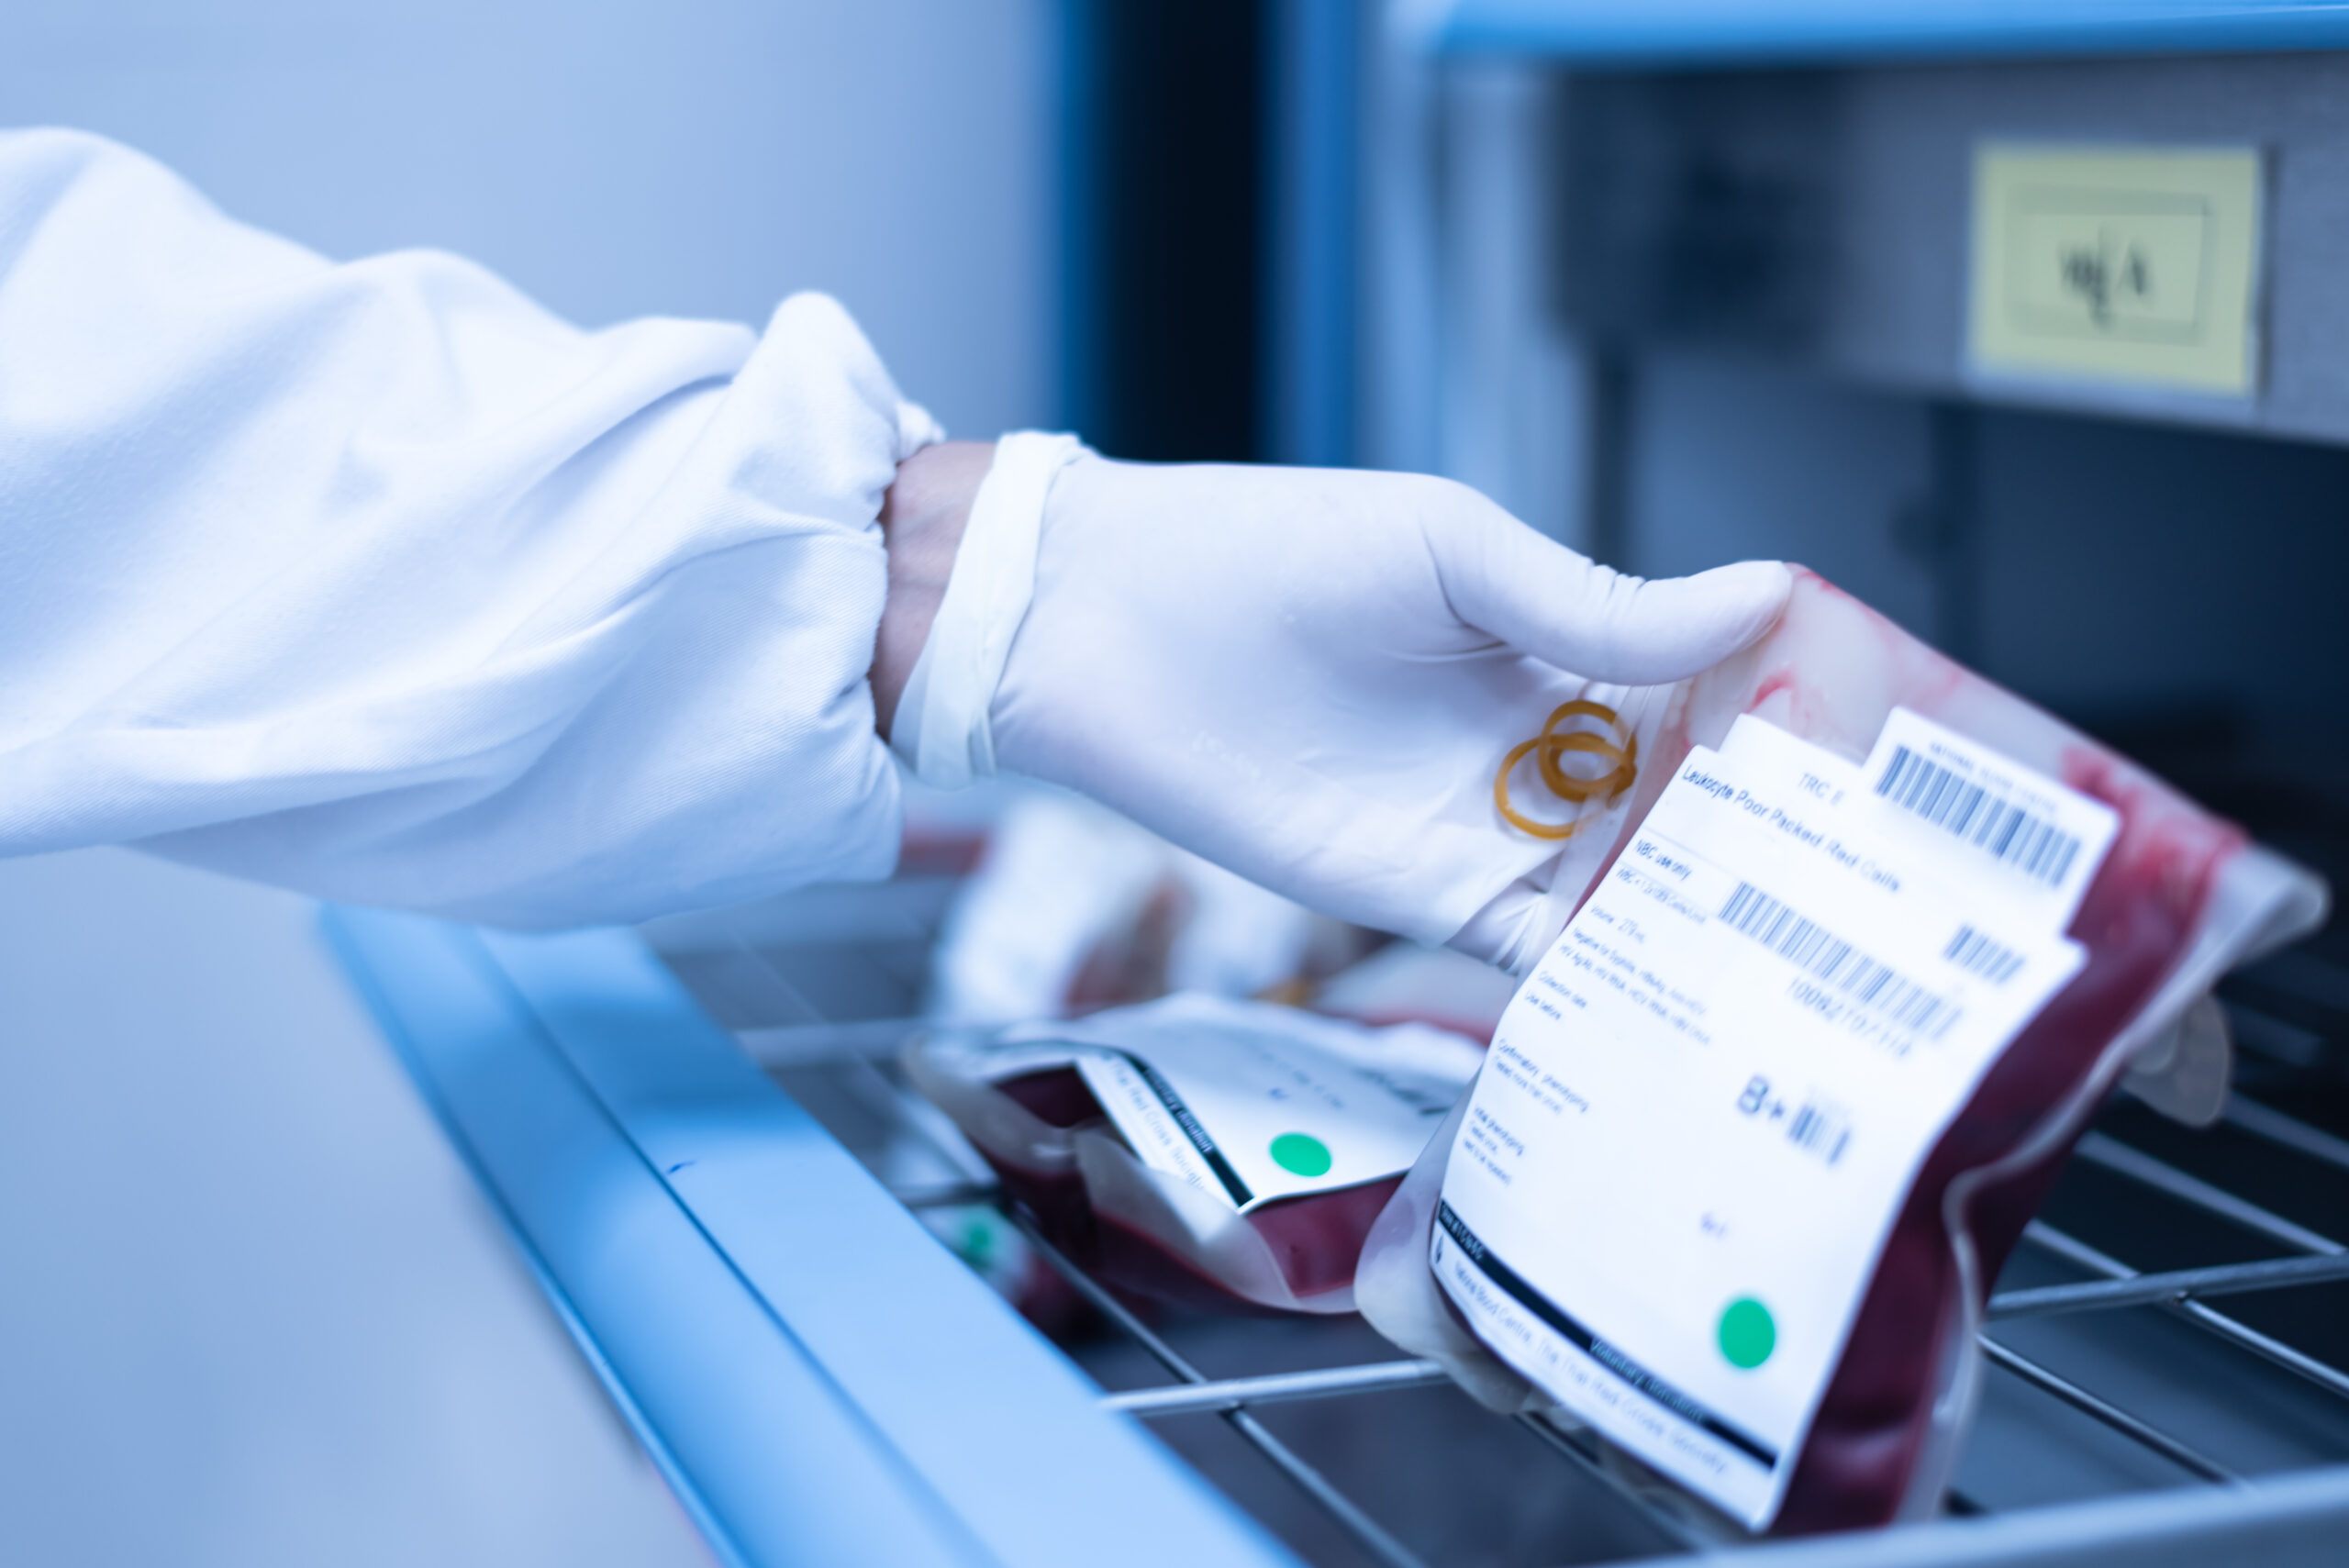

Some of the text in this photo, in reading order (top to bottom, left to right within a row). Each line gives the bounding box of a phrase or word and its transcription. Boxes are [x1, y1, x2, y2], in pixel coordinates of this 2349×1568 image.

[1635, 839, 1658, 860] NBC
[1670, 861, 1692, 882] only
[1681, 763, 1903, 894] Leukocyte Poor Packed Red Cells
